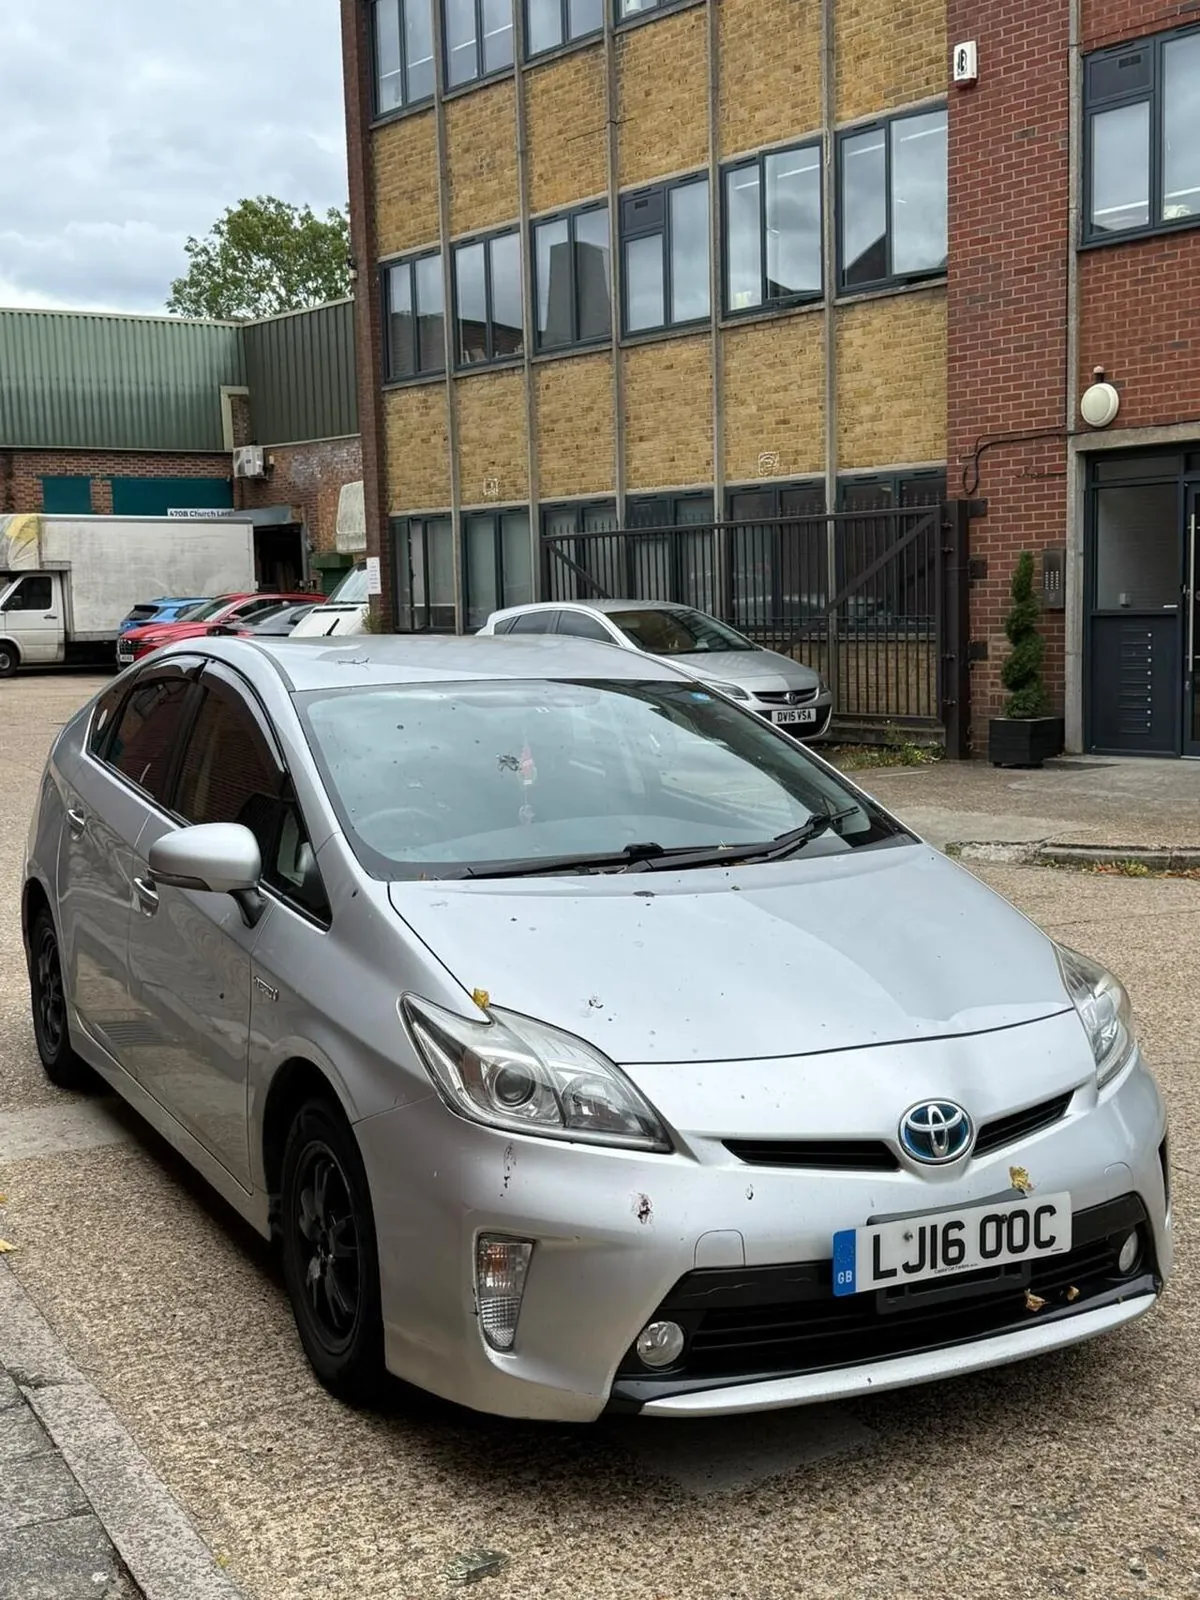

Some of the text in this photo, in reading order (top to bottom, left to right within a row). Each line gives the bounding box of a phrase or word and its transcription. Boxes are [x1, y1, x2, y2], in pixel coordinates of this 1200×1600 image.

[777, 709, 812, 722] DV15 VSA
[872, 1204, 1057, 1281] LJ16 OOC
[837, 1270, 853, 1285] GB
